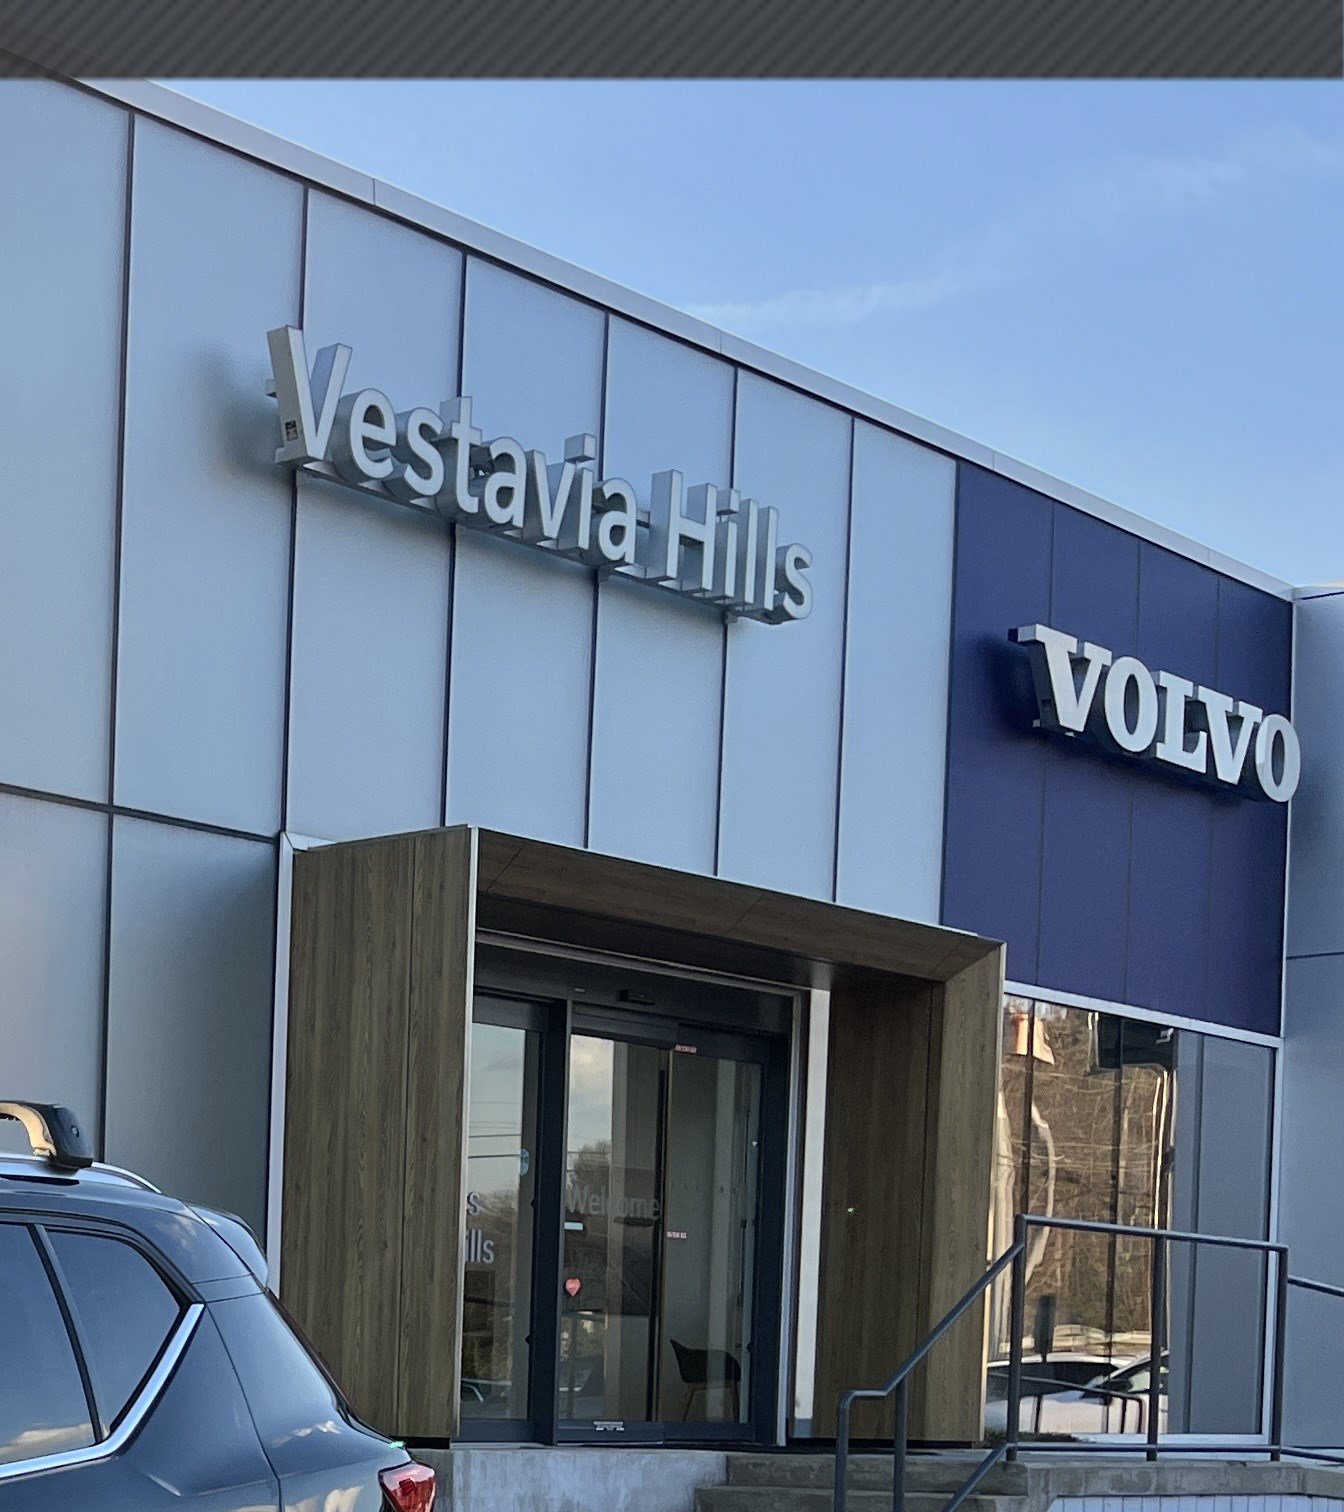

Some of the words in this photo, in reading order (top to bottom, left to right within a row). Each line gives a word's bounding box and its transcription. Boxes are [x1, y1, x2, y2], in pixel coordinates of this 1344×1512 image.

[267, 324, 638, 565] Vestavia
[651, 467, 813, 622] Hills
[1020, 623, 1301, 802] VOLVO
